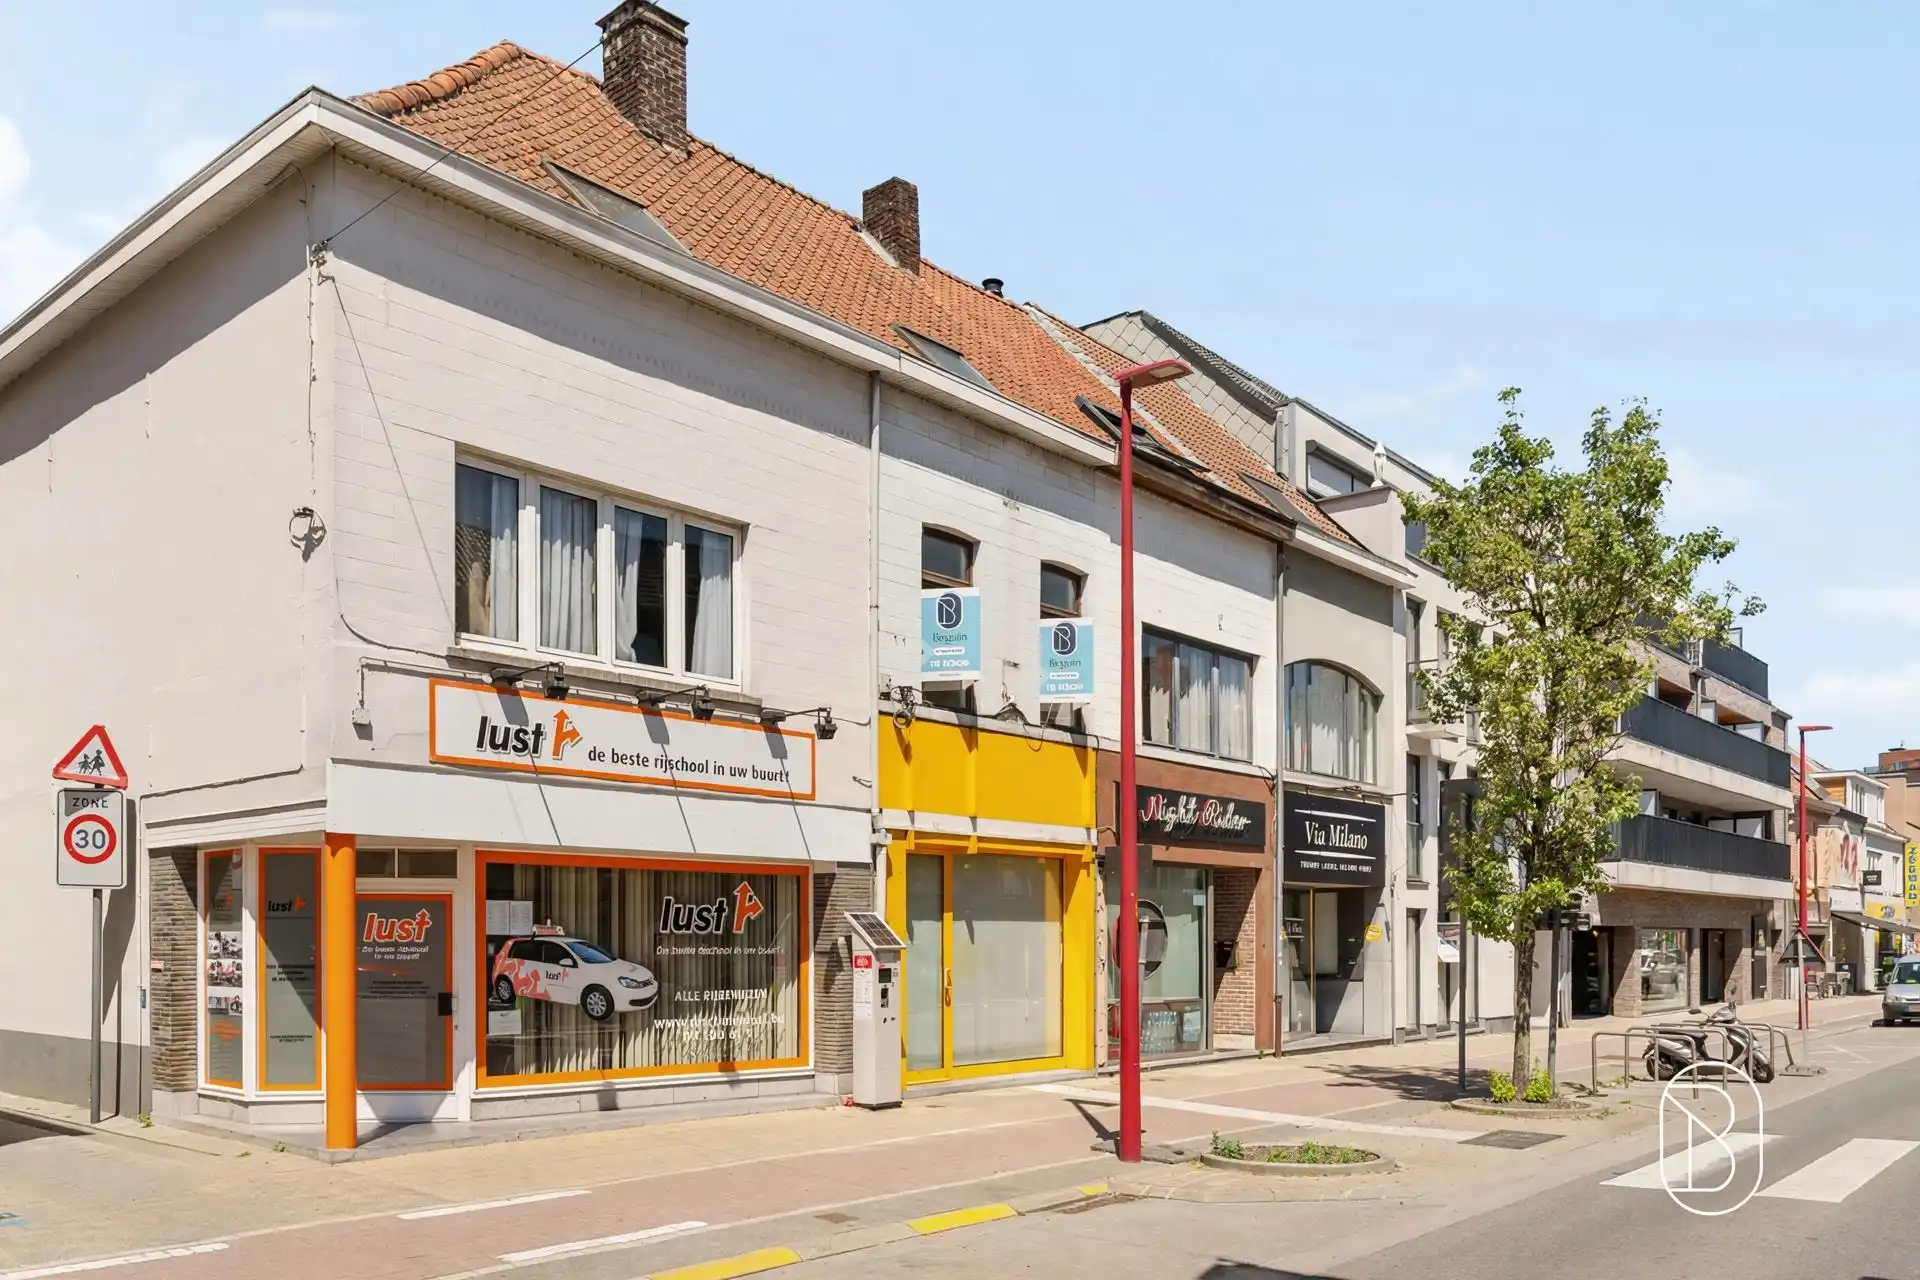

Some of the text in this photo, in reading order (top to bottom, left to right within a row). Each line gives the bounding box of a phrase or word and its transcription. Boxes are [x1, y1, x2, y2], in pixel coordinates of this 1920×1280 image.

[475, 714, 546, 757] lust
[588, 746, 606, 762] de
[611, 748, 650, 768] beste
[654, 756, 709, 774] rijschool
[713, 761, 725, 776] in
[729, 766, 748, 778] uw
[72, 797, 109, 809] ZONE
[1140, 793, 1252, 832] Night Rider
[75, 829, 106, 849] 30
[1304, 821, 1368, 850] Via Milano
[363, 908, 432, 942] lust
[660, 896, 728, 934] lust
[674, 991, 701, 1002] ALLE
